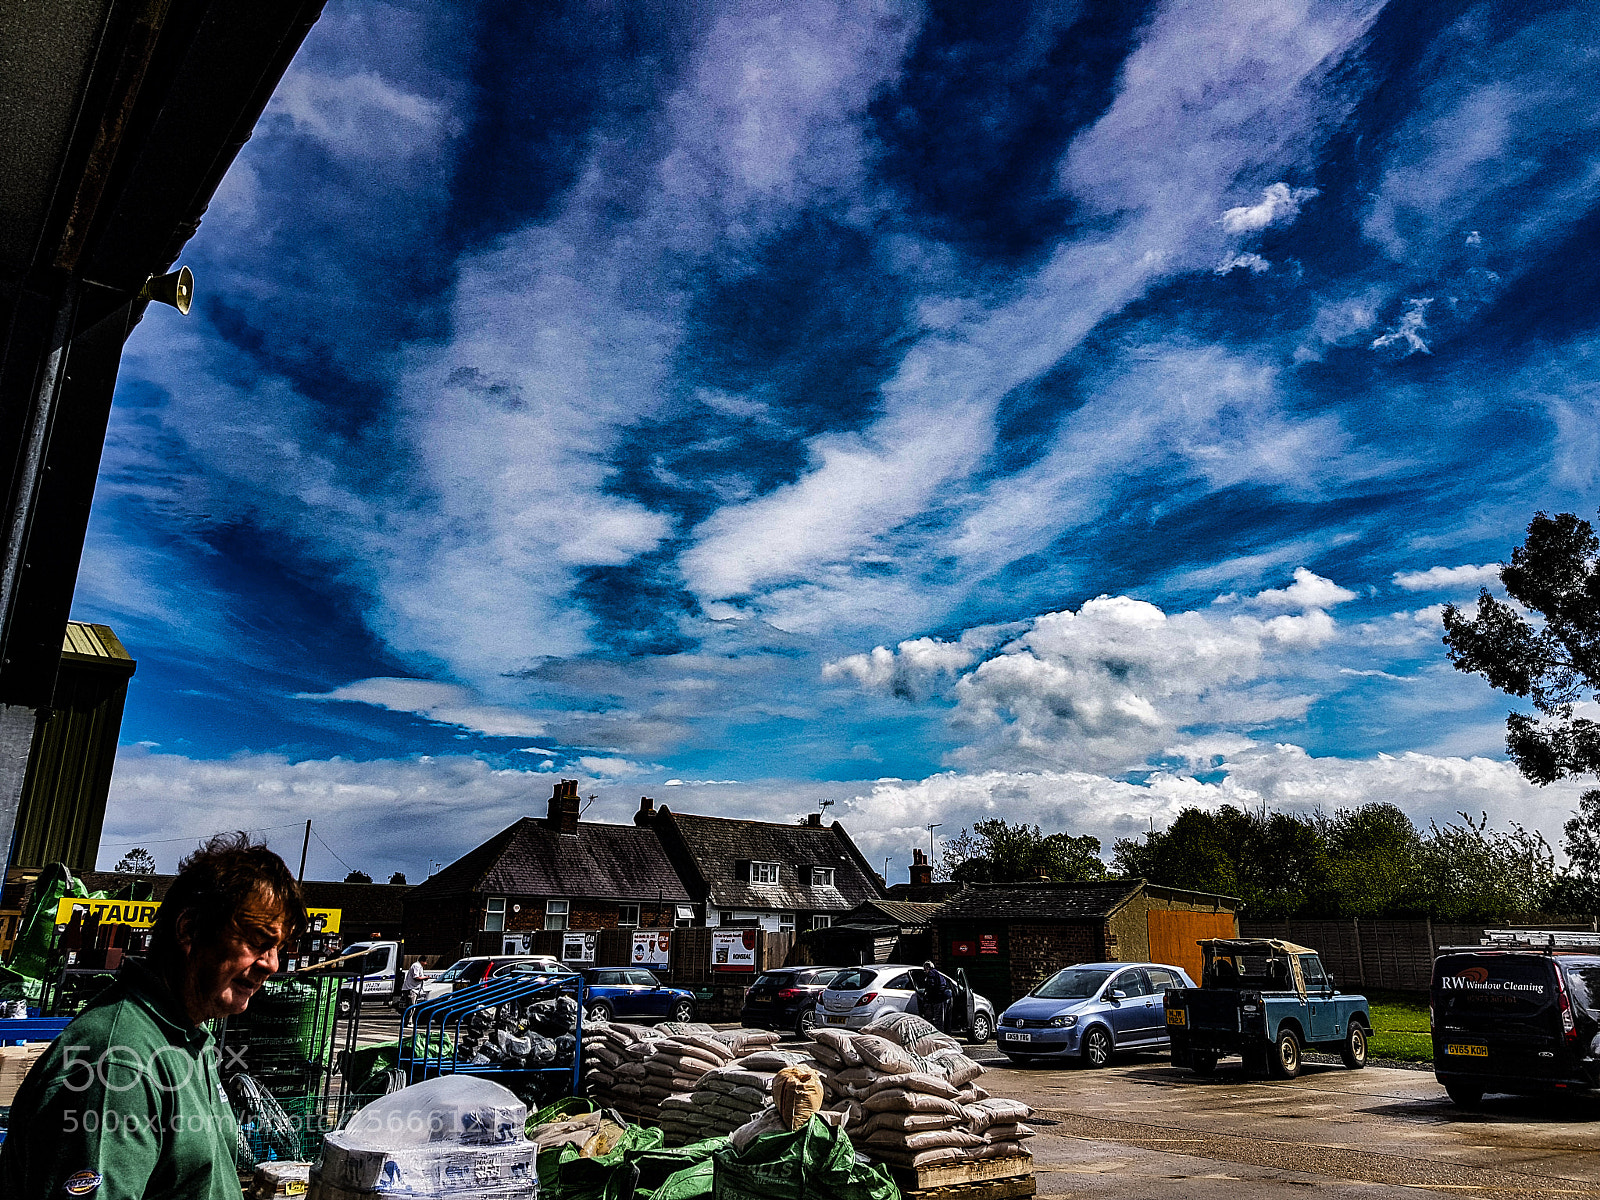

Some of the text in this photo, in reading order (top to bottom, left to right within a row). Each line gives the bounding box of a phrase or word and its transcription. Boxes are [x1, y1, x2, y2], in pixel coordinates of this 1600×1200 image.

[1441, 976, 1544, 994] RW Window Cleaning
[1449, 1045, 1469, 1054] GY65
